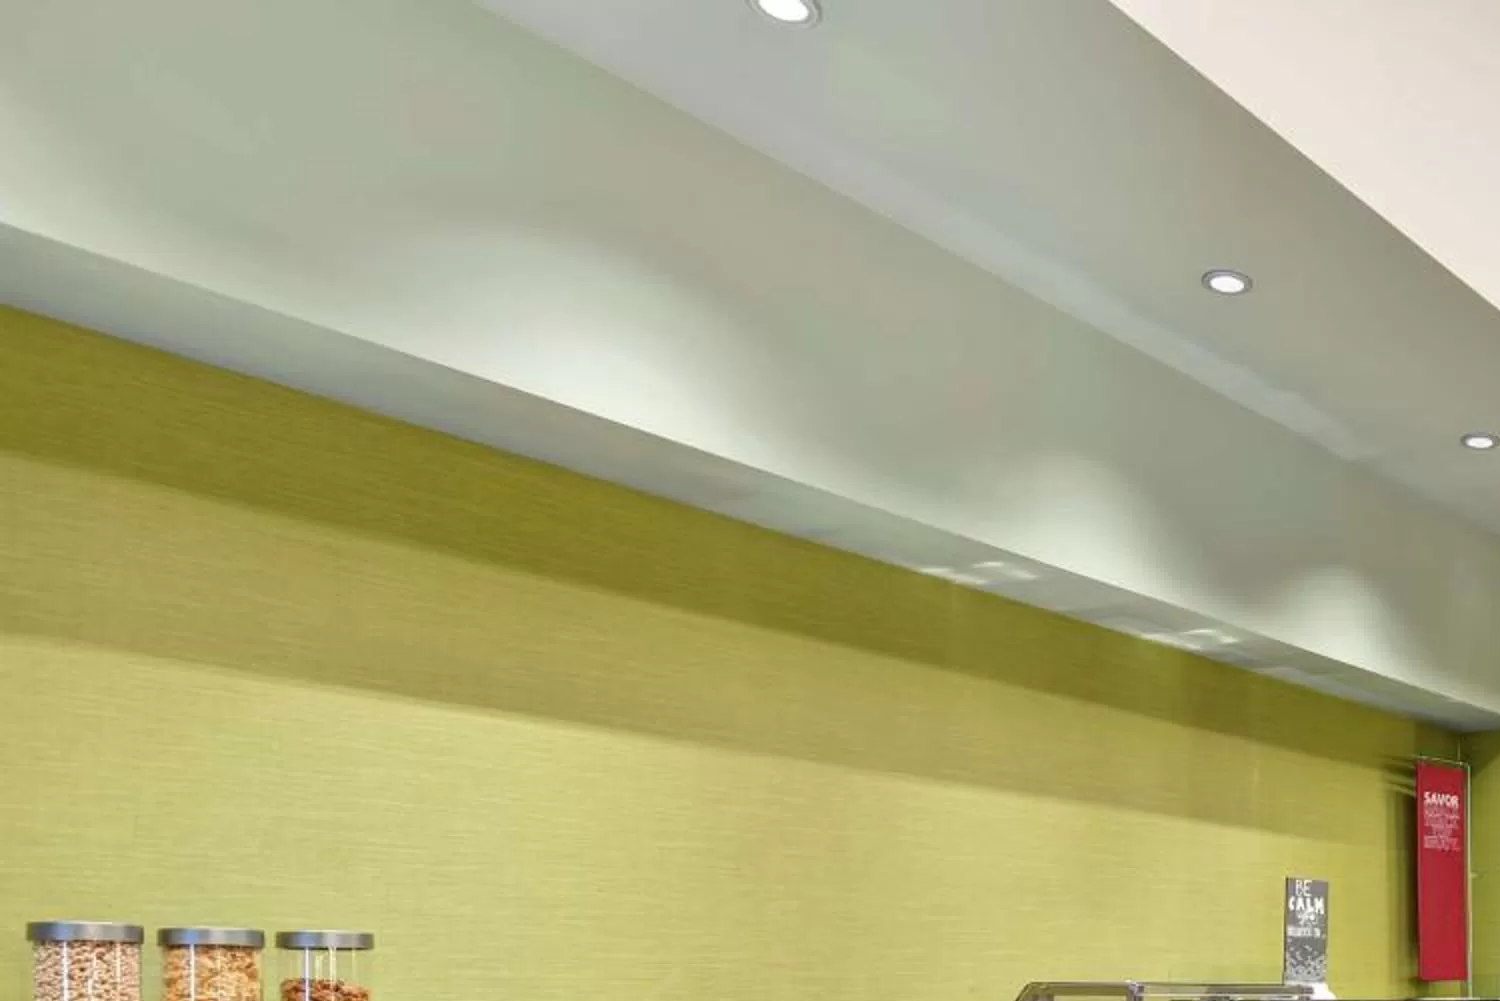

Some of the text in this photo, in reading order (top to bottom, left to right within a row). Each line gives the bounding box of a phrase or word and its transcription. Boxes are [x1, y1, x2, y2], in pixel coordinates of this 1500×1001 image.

[1424, 791, 1459, 808] SAVOR
[1296, 879, 1313, 897] BE
[1288, 896, 1325, 915] CALM
